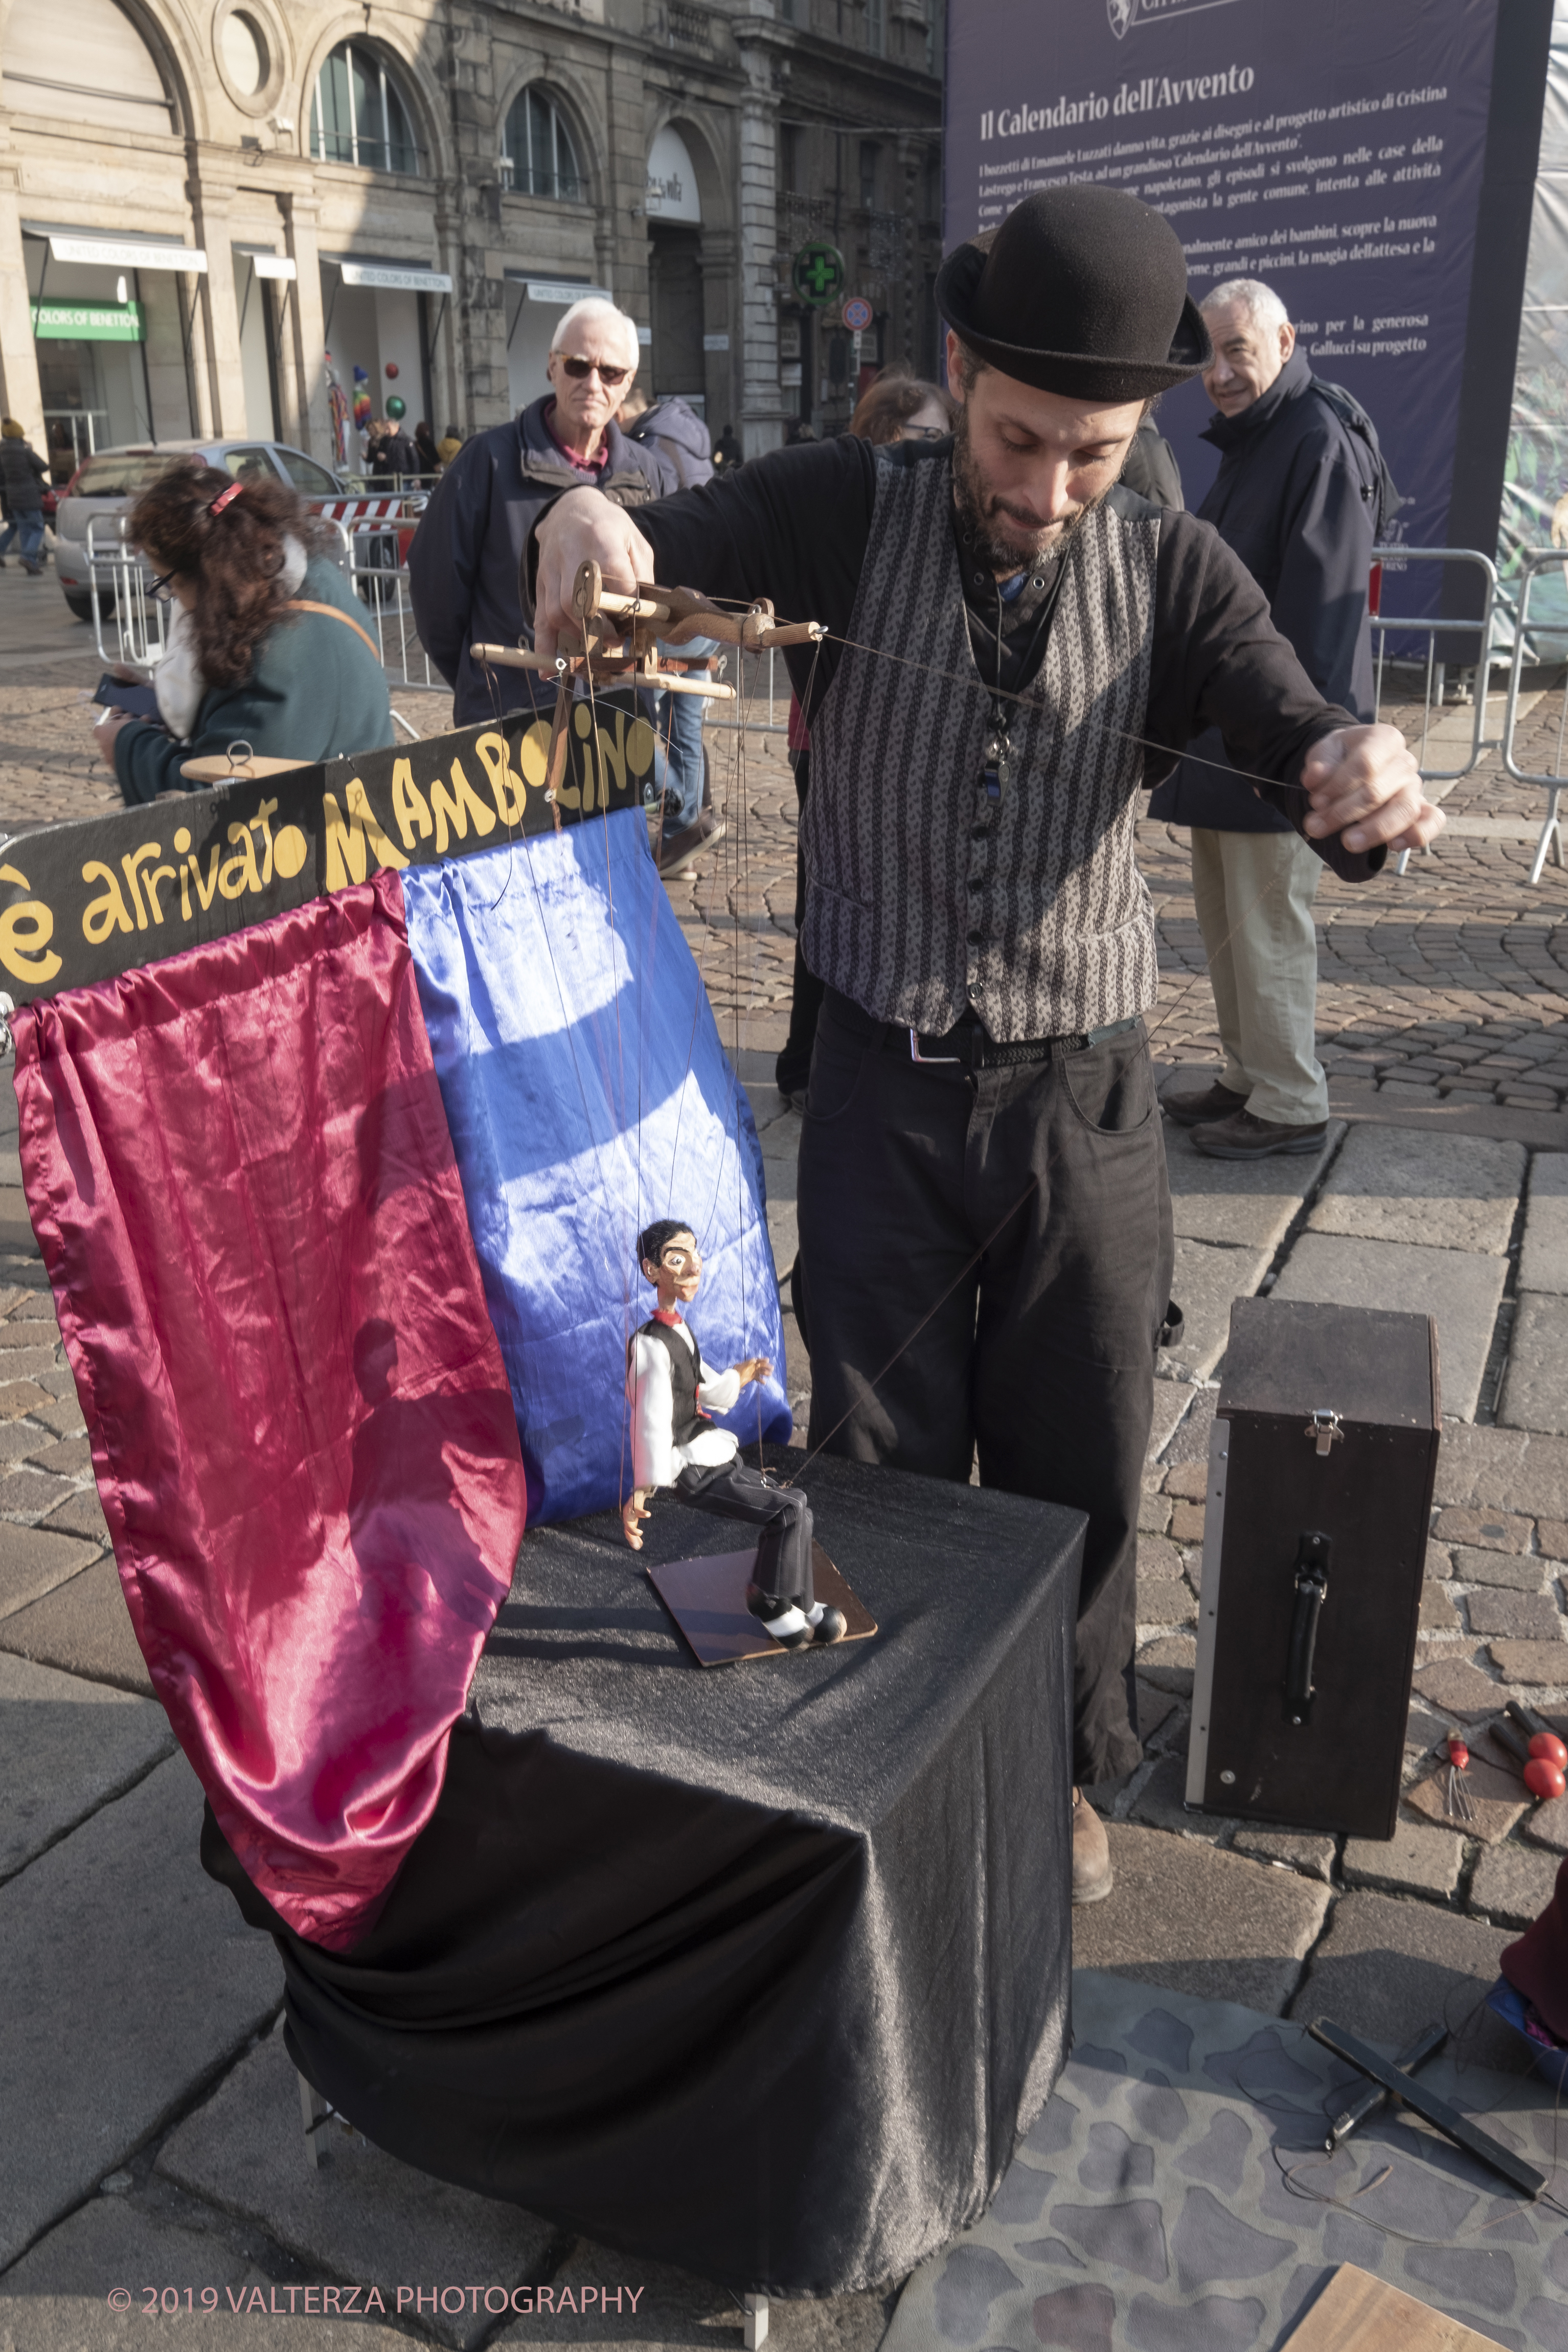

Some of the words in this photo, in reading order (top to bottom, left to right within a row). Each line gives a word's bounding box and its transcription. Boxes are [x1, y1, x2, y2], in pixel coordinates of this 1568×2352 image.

[980, 110, 994, 140] Il
[997, 92, 1109, 137] Calendario
[1112, 64, 1255, 116] dell'Avvento
[979, 165, 984, 178] I
[984, 159, 1020, 176] bozzetti
[1021, 156, 1030, 171] di
[1031, 150, 1077, 170] Emanuele
[1077, 144, 1111, 162] Luzzati
[1112, 141, 1145, 157] danno
[1168, 129, 1200, 150] grazie
[1201, 126, 1212, 142] ai
[1213, 119, 1253, 140] disegni
[1254, 121, 1262, 132] e
[1263, 114, 1274, 131] al
[1275, 107, 1327, 132] progetto
[1328, 98, 1380, 119] artistico
[1381, 92, 1395, 110] di
[1396, 85, 1447, 108] Cristina
[1095, 164, 1108, 180] ad
[1108, 166, 1122, 178] un
[1123, 156, 1173, 179] grandioso
[1207, 169, 1221, 189] gli
[1225, 162, 1265, 186] episodi
[1270, 160, 1281, 176] si
[1285, 155, 1338, 175] svolgono
[1343, 146, 1373, 166] nelle
[1378, 144, 1406, 161] case
[1412, 134, 1443, 155] della
[1212, 192, 1223, 207] la
[1227, 189, 1259, 209] gente
[1315, 174, 1360, 193] intenta
[1365, 168, 1388, 187] alle
[1393, 161, 1442, 183] attività
[1235, 233, 1268, 250] amico
[1269, 229, 1287, 246] dei
[1341, 221, 1381, 239] scopre
[1383, 216, 1396, 233] la
[1398, 215, 1438, 232] nuova
[63, 244, 100, 259] UNITED
[101, 247, 138, 262] COLORS
[139, 251, 151, 262] OF
[1212, 255, 1248, 277] grandi
[1249, 258, 1258, 270] e
[1298, 249, 1309, 265] la
[1311, 246, 1348, 266] magia
[1412, 241, 1421, 255] e
[1422, 236, 1435, 253] la
[74, 310, 87, 326] OF
[89, 311, 139, 328] BENETTON
[1325, 320, 1347, 336] per
[1353, 314, 1365, 331] la
[1371, 313, 1429, 333] generosa
[1309, 339, 1355, 356] Gallucci
[1356, 342, 1371, 354] su
[1371, 336, 1427, 357] progetto
[82, 797, 307, 944] arrivato
